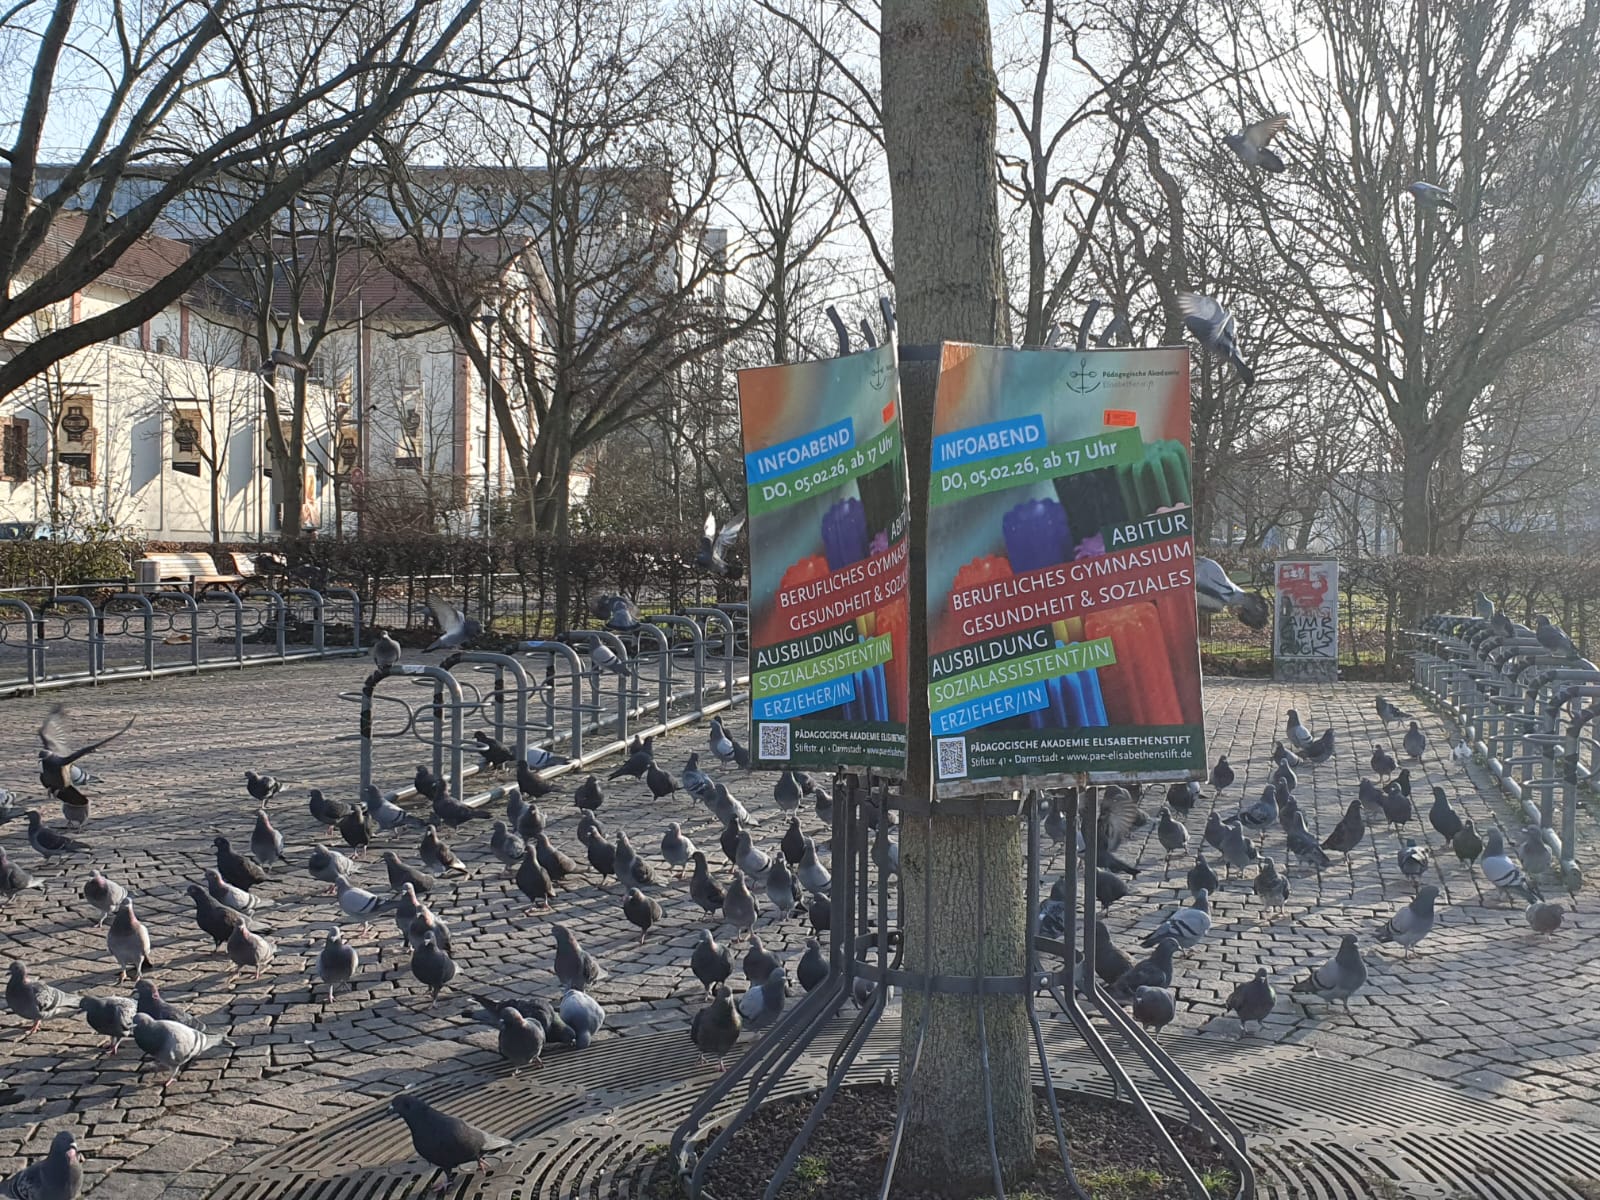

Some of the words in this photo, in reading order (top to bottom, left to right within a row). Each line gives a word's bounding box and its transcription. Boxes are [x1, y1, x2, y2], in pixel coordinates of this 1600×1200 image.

[758, 427, 850, 475] INFOABEND
[940, 424, 1040, 462] INFOABEND
[762, 482, 792, 500] DO,
[794, 458, 849, 493] 05.02.26,
[851, 450, 865, 469] ab
[867, 447, 877, 464] 17
[879, 435, 893, 455] Uhr
[941, 473, 967, 492] DO,
[970, 459, 1040, 488] 05.02.26,
[1043, 451, 1062, 469] ab
[1066, 451, 1081, 467] 17
[1085, 441, 1117, 460] Uhr
[1111, 513, 1189, 546] ABITUR
[779, 566, 864, 608] BERUFLICHES
[952, 570, 1065, 611] BERUFLICHES
[1070, 541, 1192, 581] GYMNASIUM
[790, 586, 871, 631] GESUNDHEIT
[874, 585, 883, 603] &
[963, 594, 1074, 636] GESUNDHEIT
[1080, 590, 1096, 607] &
[1098, 569, 1192, 603] SOZIALES
[757, 625, 855, 668] AUSBILDUNG
[759, 639, 891, 691] SOZIALASSISTENT/IN
[932, 630, 1049, 678] AUSBILDUNG
[934, 642, 1110, 703] SOZIALASSISTENT/IN
[764, 681, 850, 717] ERZIEHER/IN
[940, 687, 1042, 731] ERZIEHER/IN
[850, 731, 880, 741] AKADEMIE
[970, 740, 1039, 753] PÄDAGOGISCHE
[1040, 738, 1090, 749] AKADEMIE
[1093, 735, 1191, 747] ELISABETHENSTIFT
[1015, 752, 1059, 764] Darmstadt
[1067, 748, 1192, 762] www.pae-elisabethenstift.de
